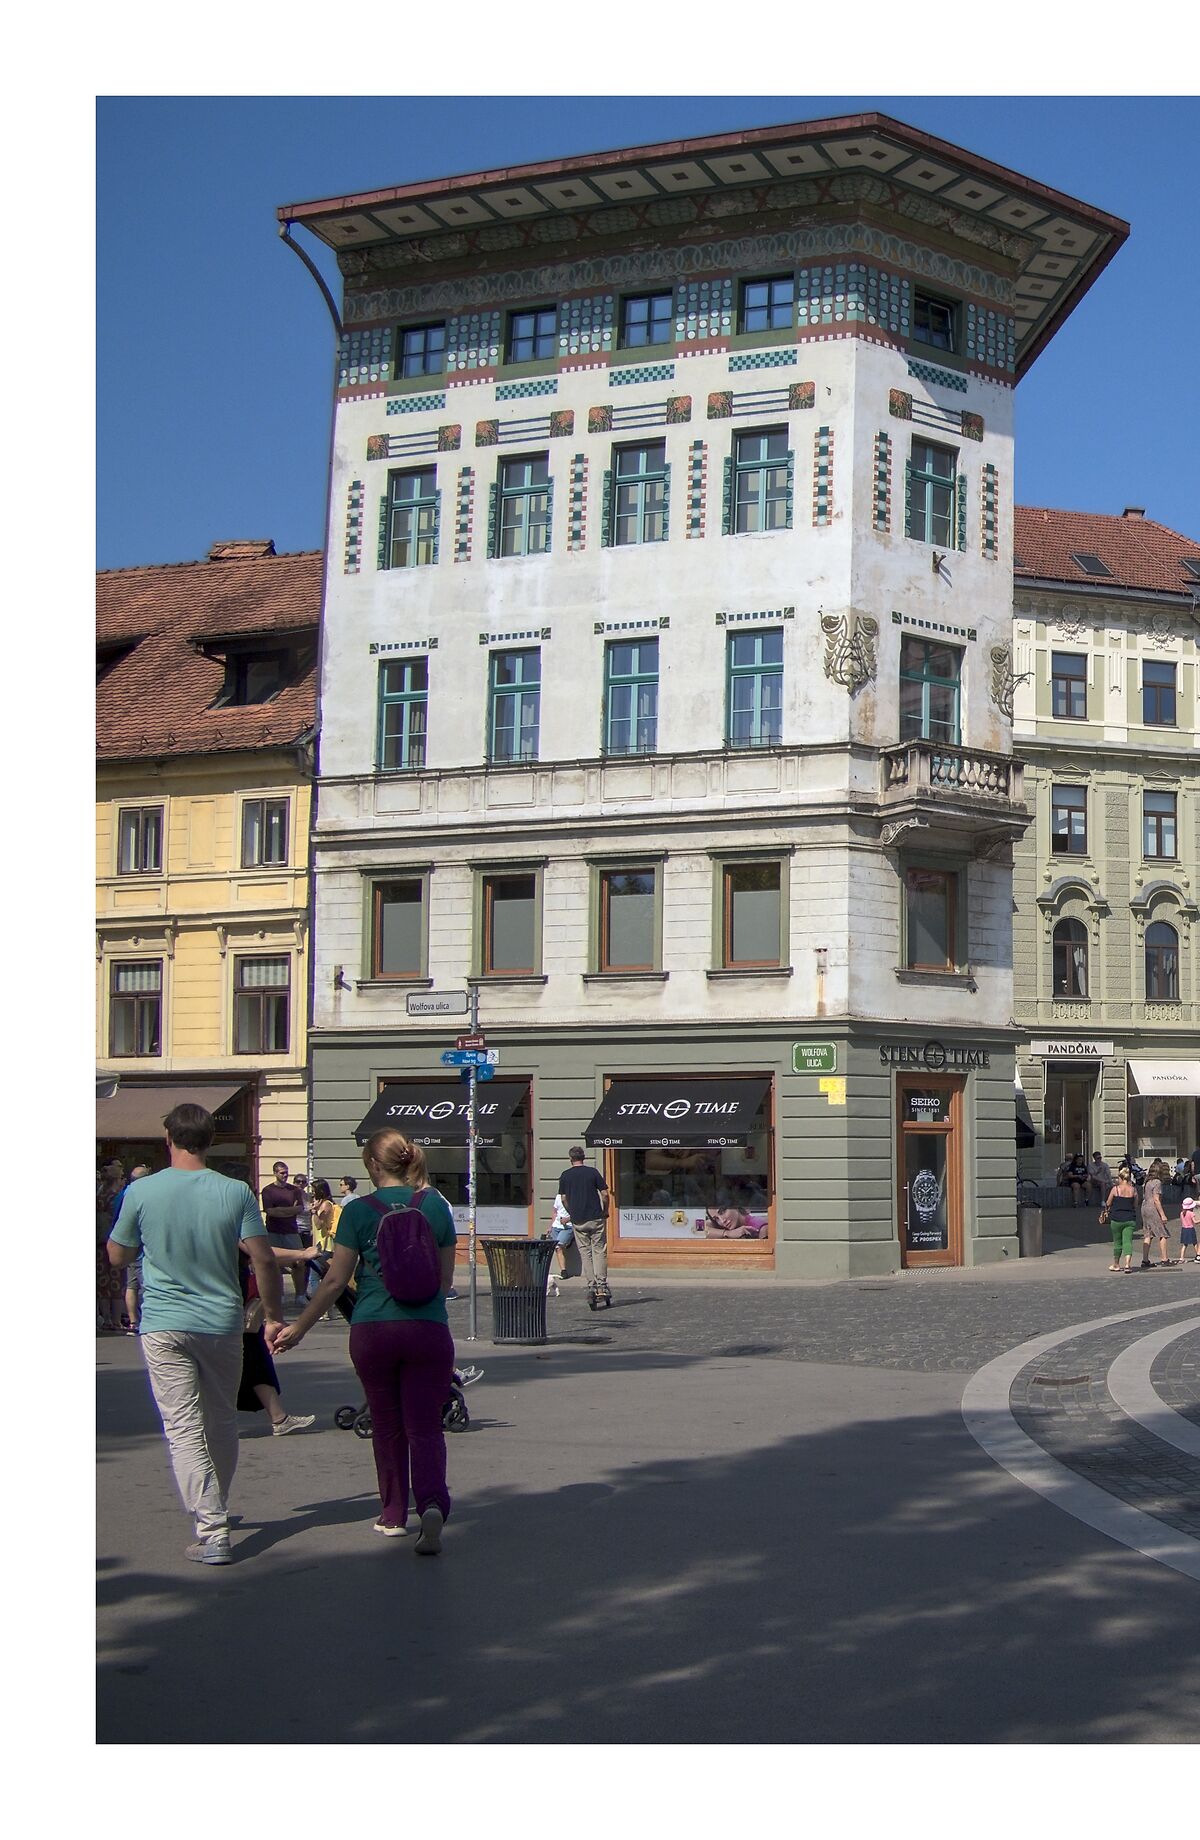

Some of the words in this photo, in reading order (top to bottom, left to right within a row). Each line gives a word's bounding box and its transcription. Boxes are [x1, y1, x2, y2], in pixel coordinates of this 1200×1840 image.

[410, 1003, 434, 1011] Wolfova
[435, 1002, 449, 1010] ulica
[801, 1048, 828, 1056] WOLFOVA
[1048, 1042, 1098, 1054] PANDORA
[879, 1045, 919, 1062] STEN
[945, 1048, 989, 1066] TIME
[806, 1058, 823, 1067] ULICA
[911, 1097, 940, 1106] SEIKO
[386, 1104, 429, 1115] STEN
[617, 1103, 662, 1115] STEN
[694, 1102, 740, 1114] TIME
[635, 1213, 665, 1221] JAKOBS
